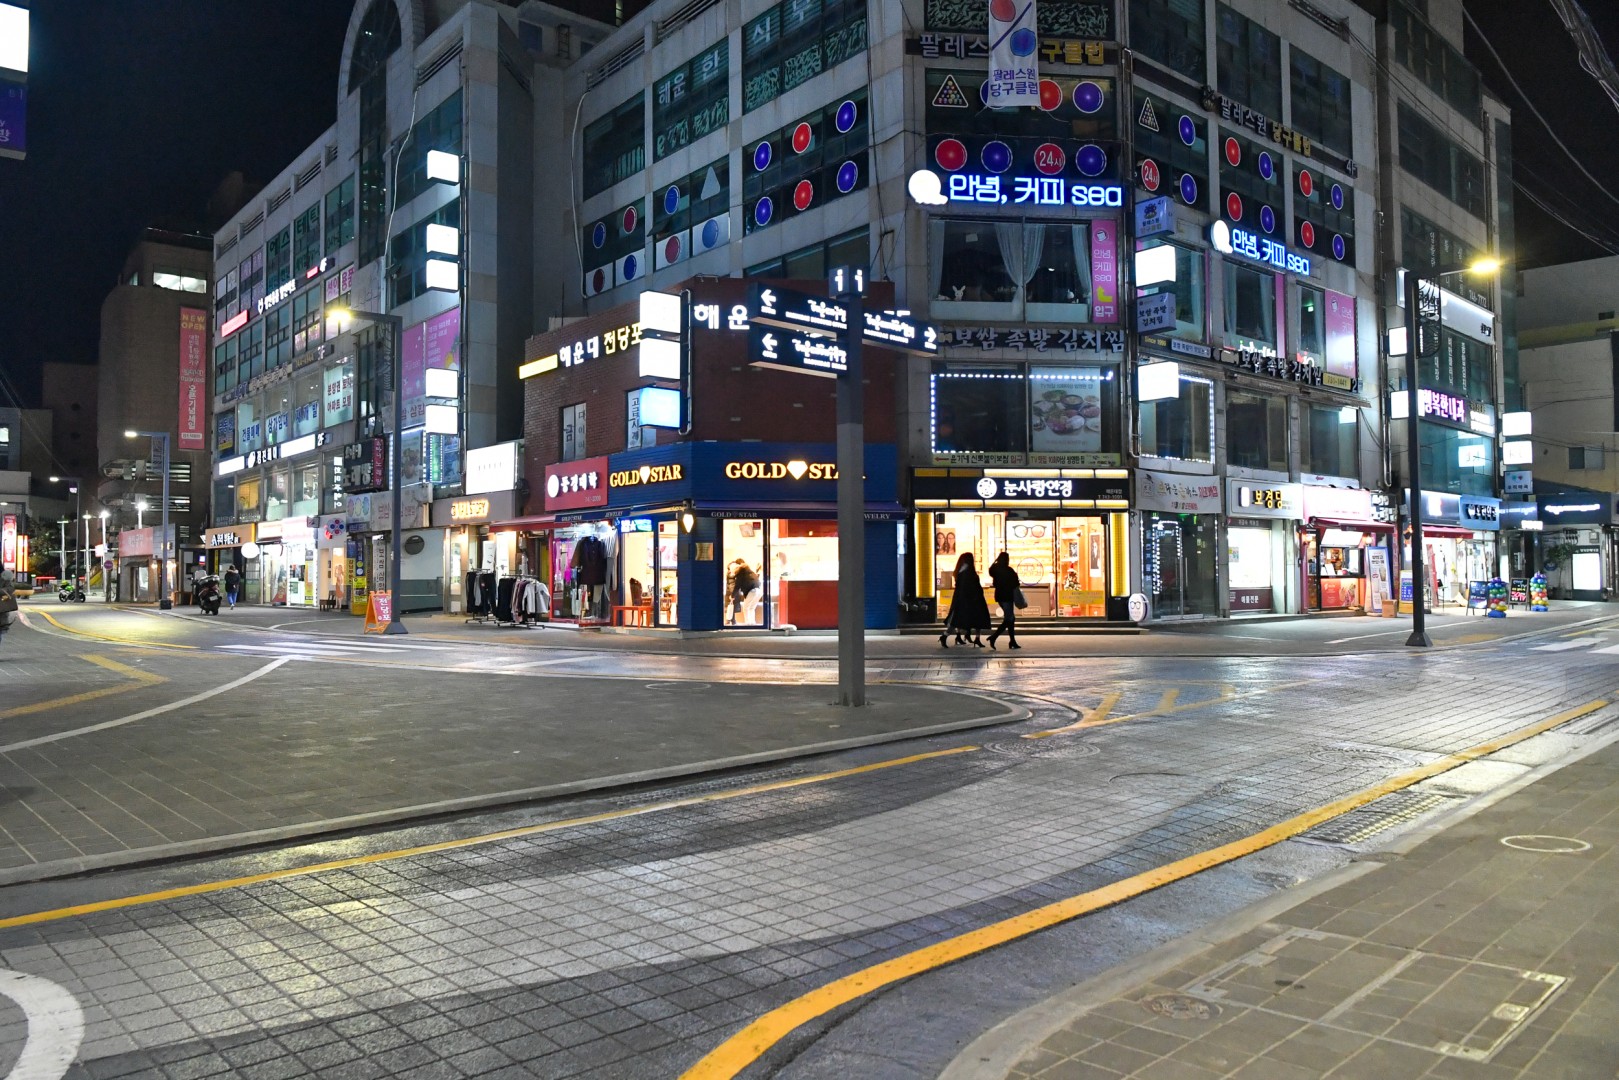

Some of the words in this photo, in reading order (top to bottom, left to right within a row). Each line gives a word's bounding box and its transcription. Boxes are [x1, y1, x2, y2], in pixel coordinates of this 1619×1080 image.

[993, 68, 1036, 82] 팔레스원
[990, 82, 1038, 98] 당구클럽
[1220, 97, 1267, 136] 팔레스원
[1272, 121, 1311, 158] 당구클럽
[1039, 150, 1063, 167] 24시
[950, 174, 1008, 205] 안녕,
[1014, 176, 1065, 205] 커피
[1071, 184, 1122, 206] sea
[1093, 249, 1114, 260] 안녕,
[1232, 228, 1261, 260] 안녕,
[1262, 238, 1286, 268] 커피
[1287, 253, 1310, 276] sea
[1094, 260, 1112, 271] 커피
[1094, 274, 1112, 282] sea
[182, 314, 205, 322] NEW
[1095, 305, 1114, 318] 입구
[181, 322, 205, 330] OPEN
[559, 335, 600, 367] 해운대
[604, 322, 643, 355] 전당포
[954, 327, 999, 351] 보쌈
[1005, 328, 1052, 352] 족발
[1058, 328, 1126, 353] 김치찜
[610, 470, 640, 487] GOLD
[650, 464, 682, 482] STAR
[725, 462, 787, 479] GOLD
[809, 463, 852, 479] ST
[1003, 480, 1073, 497] 눈사랑안경
[380, 597, 391, 620] 전당포
